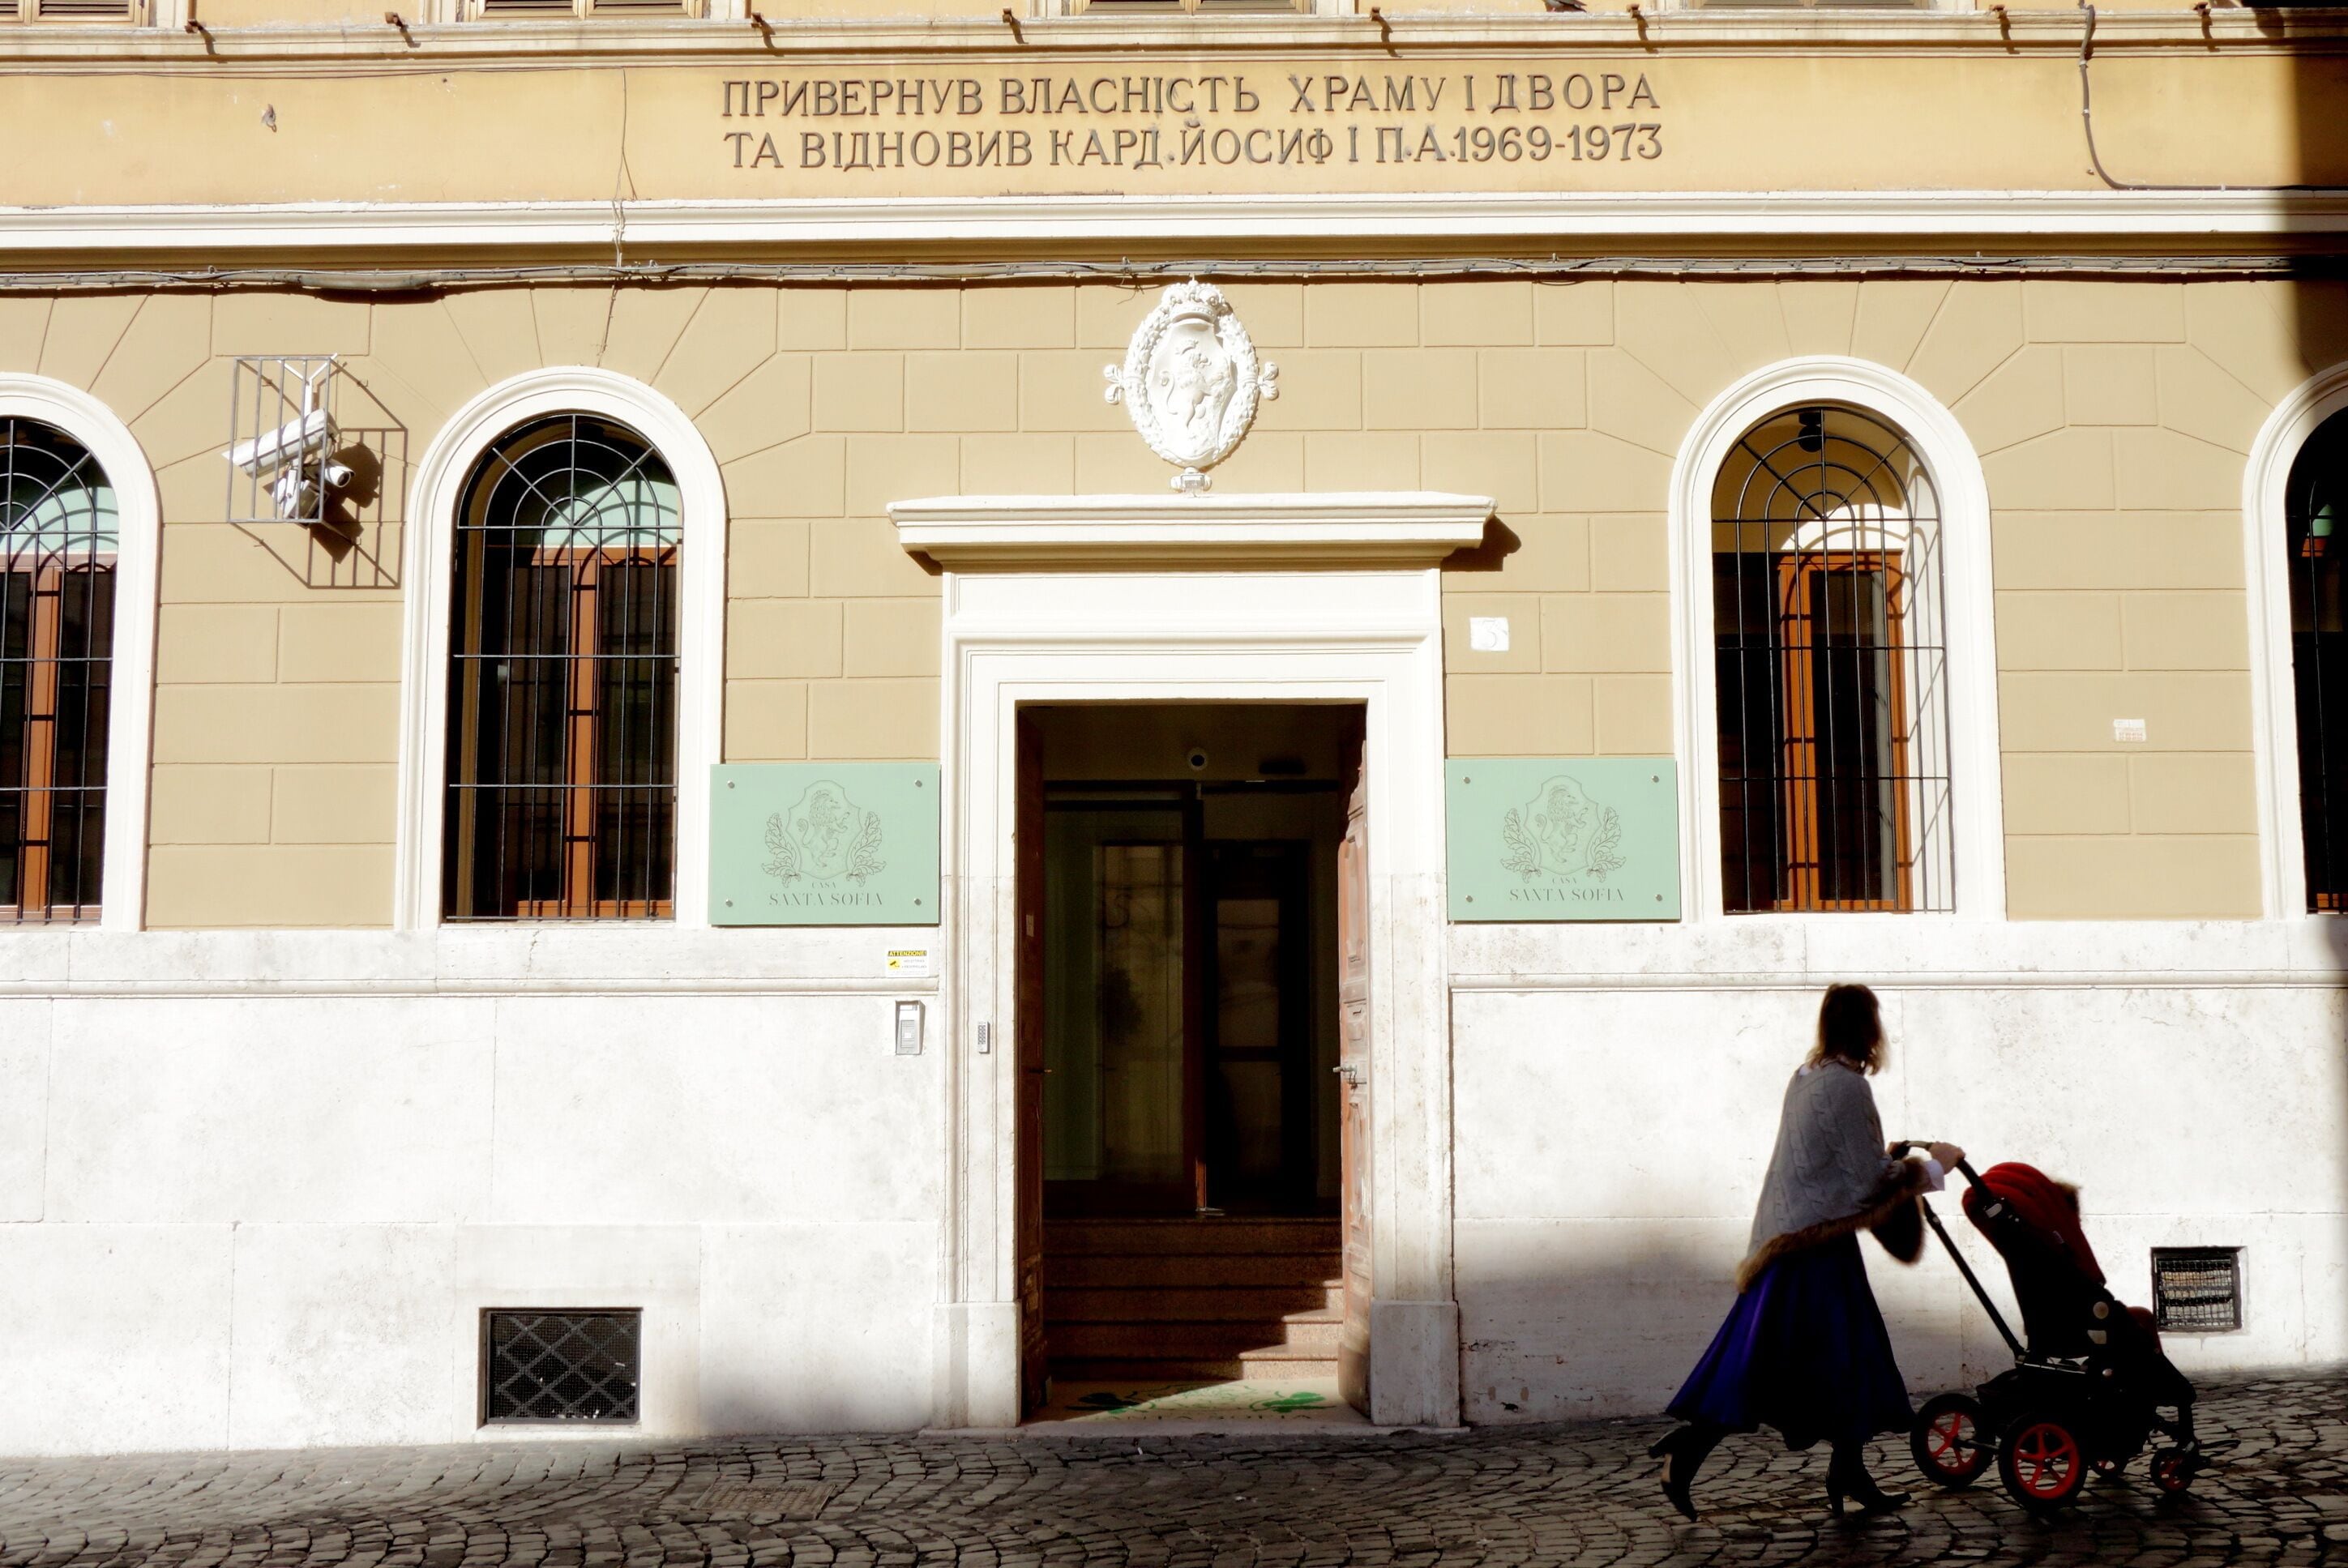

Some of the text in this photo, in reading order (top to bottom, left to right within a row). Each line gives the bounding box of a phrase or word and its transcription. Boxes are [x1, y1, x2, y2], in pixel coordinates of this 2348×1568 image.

[722, 73, 1661, 117] ПРИВЕРНУВ ВЛАСНІСТЬ ХРАМУ І ДВОРА
[723, 131, 784, 169] ТА
[799, 130, 1033, 173] ВІДНОВИВ
[1347, 125, 1359, 163] І
[811, 881, 836, 889] CASA
[768, 892, 883, 906] SANTA SOFIA
[1509, 888, 1624, 901] SANTA SOFIA
